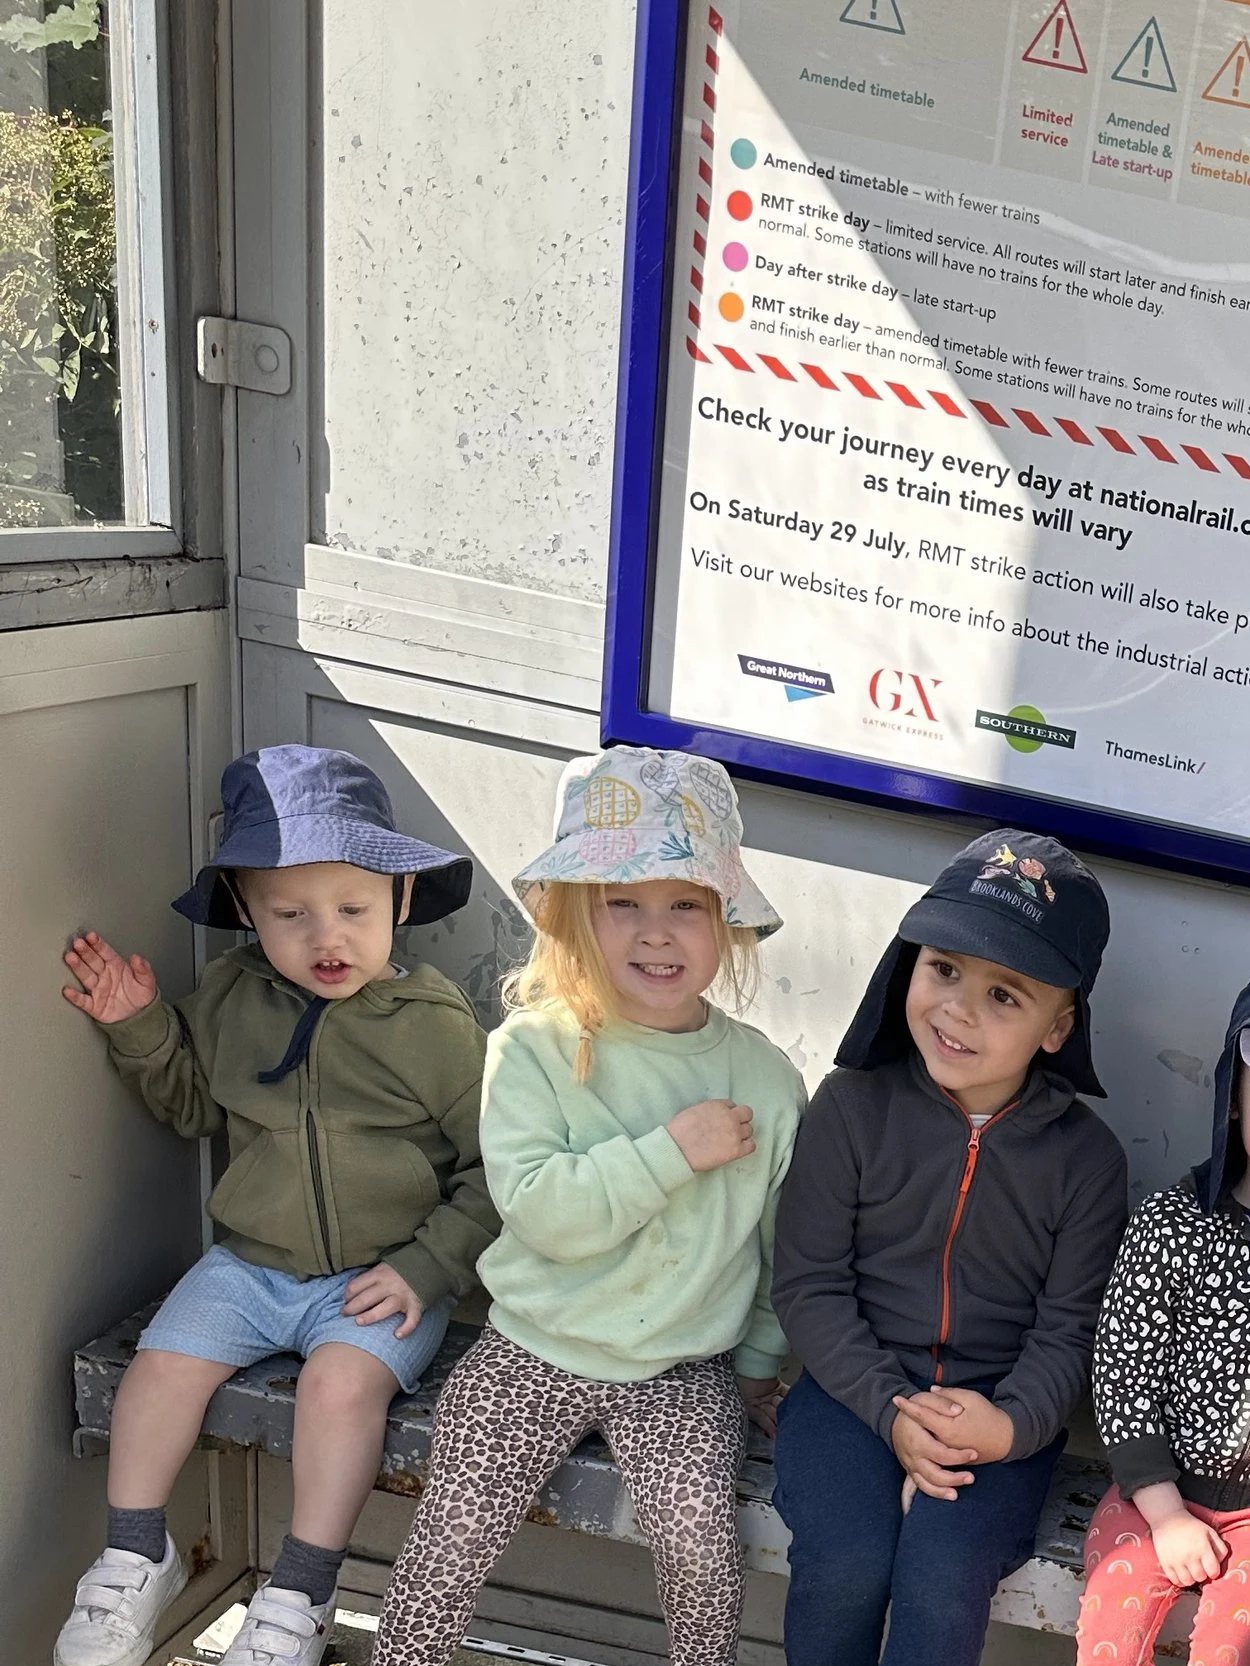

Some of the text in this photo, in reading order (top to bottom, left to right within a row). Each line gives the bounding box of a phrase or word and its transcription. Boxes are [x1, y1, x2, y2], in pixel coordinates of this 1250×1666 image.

[799, 68, 935, 108] Amended timetable
[1021, 127, 1068, 147] service
[1022, 105, 1073, 127] Limited
[1106, 112, 1170, 137] Amended
[1092, 151, 1173, 182] Late start-up
[1098, 132, 1172, 158] timetable &
[764, 153, 834, 180] Amended
[840, 170, 908, 196] timetable
[924, 188, 954, 206] with
[958, 194, 998, 216] fewer
[1002, 204, 1040, 224] trains
[759, 217, 1164, 317] normal. Some stations will have no trains for the whole day.
[761, 193, 794, 212] RMT
[798, 202, 838, 222] strike
[843, 211, 870, 231] day
[886, 219, 933, 243] limited
[937, 232, 988, 255] service.
[992, 243, 1011, 260] All
[1016, 249, 1059, 269] routes
[1063, 260, 1085, 275] will
[1089, 266, 1120, 284] start
[1125, 270, 1156, 290] later
[1160, 281, 1186, 297] and
[1190, 285, 1225, 305] finish
[756, 255, 783, 276] Day
[788, 262, 822, 282] after
[827, 272, 867, 292] strike
[872, 280, 898, 300] day
[913, 288, 939, 307] late
[943, 299, 997, 323] start-up
[750, 319, 775, 334] and
[779, 322, 815, 343] finish
[819, 333, 861, 353] earlier
[866, 341, 895, 360] than
[900, 350, 950, 371] normal.
[954, 361, 993, 381] Some
[997, 371, 1049, 393] stations
[1053, 383, 1076, 399] will
[1080, 387, 1111, 406] have
[1115, 398, 1132, 411] no
[1137, 400, 1174, 420] trains
[1177, 408, 1197, 424] for
[1201, 413, 1222, 430] the
[752, 295, 785, 314] RMT
[789, 304, 829, 324] strike
[834, 313, 860, 333] day
[875, 324, 939, 348] amended
[943, 338, 1008, 363] timetable
[1012, 350, 1040, 369] with
[1045, 357, 1083, 378] fewer
[1087, 368, 1127, 389] trains.
[1133, 377, 1171, 398] Some
[1175, 389, 1218, 408] routes
[1222, 399, 1244, 413] will
[698, 396, 772, 433] Check
[779, 419, 835, 445] your
[840, 426, 934, 472] journey
[942, 455, 1010, 488] every
[1018, 466, 1062, 499] day
[1068, 480, 1094, 501] at
[863, 474, 1132, 550] as train times will vary
[690, 492, 721, 515] On
[728, 499, 824, 541] Saturday
[831, 522, 856, 543] 29
[863, 529, 910, 559] July,
[918, 539, 966, 567] RMT
[971, 553, 1026, 580] strike
[1033, 570, 1093, 594] action
[1101, 582, 1134, 604] will
[1139, 588, 1179, 613] also
[1186, 600, 1229, 624] take
[691, 547, 733, 574] Visit
[740, 562, 773, 582] our
[780, 571, 868, 603] websites
[875, 586, 903, 610] for
[910, 599, 961, 623] more
[968, 606, 1005, 632] info
[1012, 618, 1071, 647] about
[1077, 631, 1109, 655] the
[1116, 639, 1208, 676] industrial
[746, 661, 826, 686] Great Northern
[869, 668, 943, 722] GX
[863, 717, 944, 741] GATWICK EXPRESS
[980, 715, 1071, 743] SOUTHERN
[972, 881, 1042, 921] BROOKLANDS COVE
